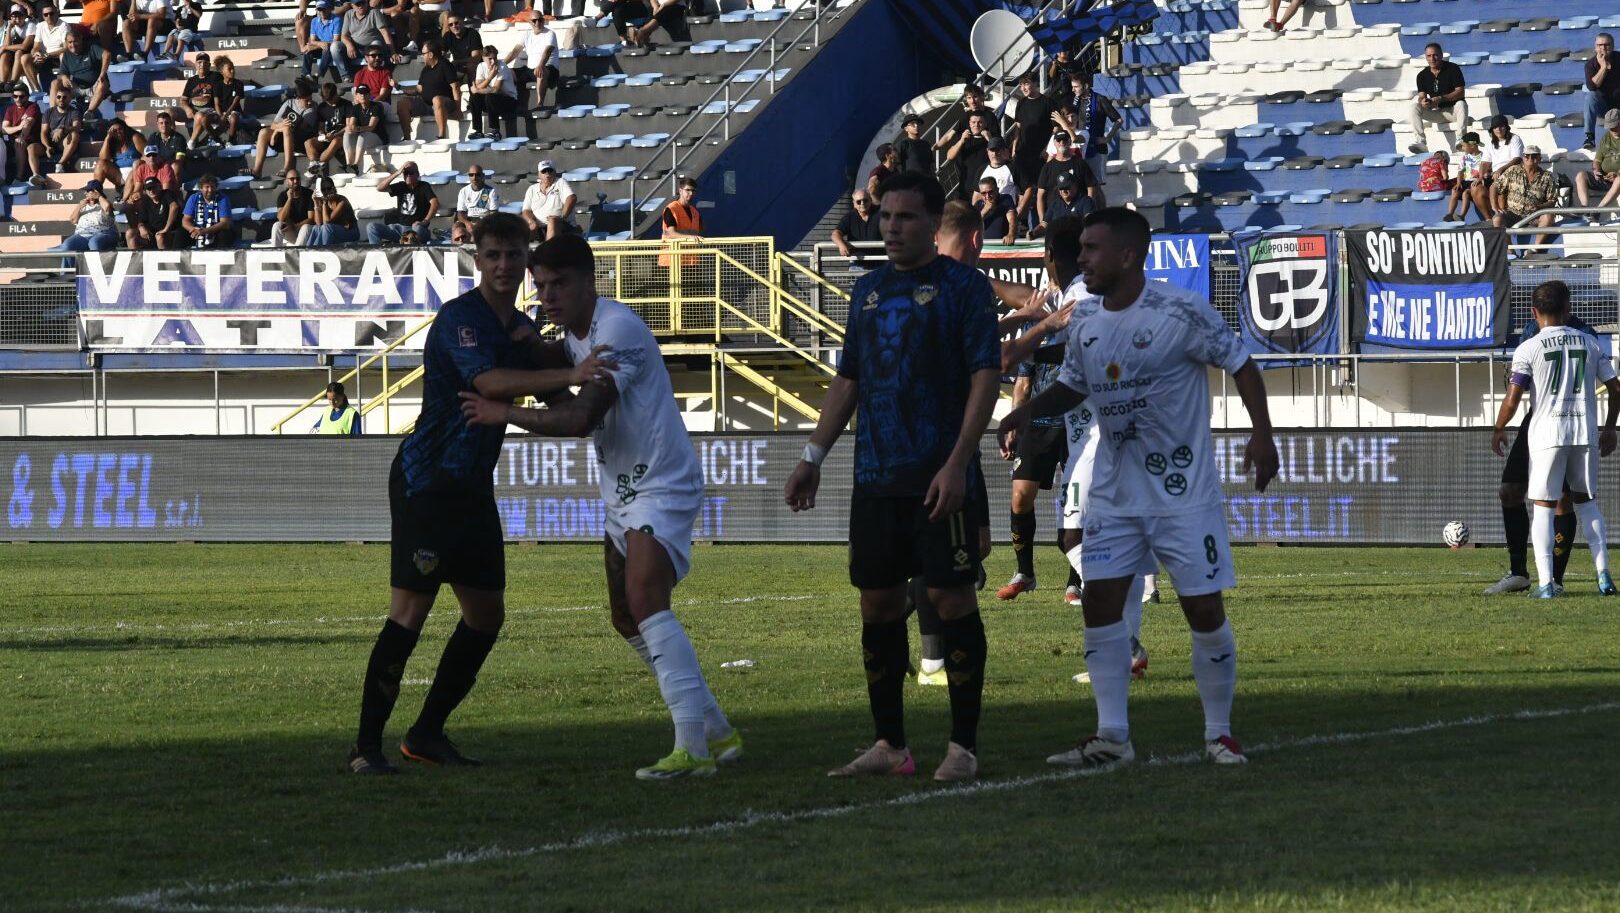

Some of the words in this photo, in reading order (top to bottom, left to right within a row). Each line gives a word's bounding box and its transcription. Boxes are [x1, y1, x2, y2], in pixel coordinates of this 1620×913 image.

[218, 39, 236, 48] FILA
[239, 39, 248, 47] 10
[150, 99, 168, 108] FILA
[46, 192, 65, 201] FILA
[9, 224, 28, 234] FILA
[31, 223, 37, 233] 4
[1401, 230, 1487, 275] PONTINO
[1369, 293, 1379, 336] E
[1435, 291, 1491, 341] VANTO!
[1541, 335, 1587, 349] VITERITTI
[1544, 349, 1588, 396] 77
[493, 442, 577, 486] TURE
[7, 452, 34, 529] &
[47, 453, 157, 529] STEEL
[1203, 534, 1218, 565] 8
